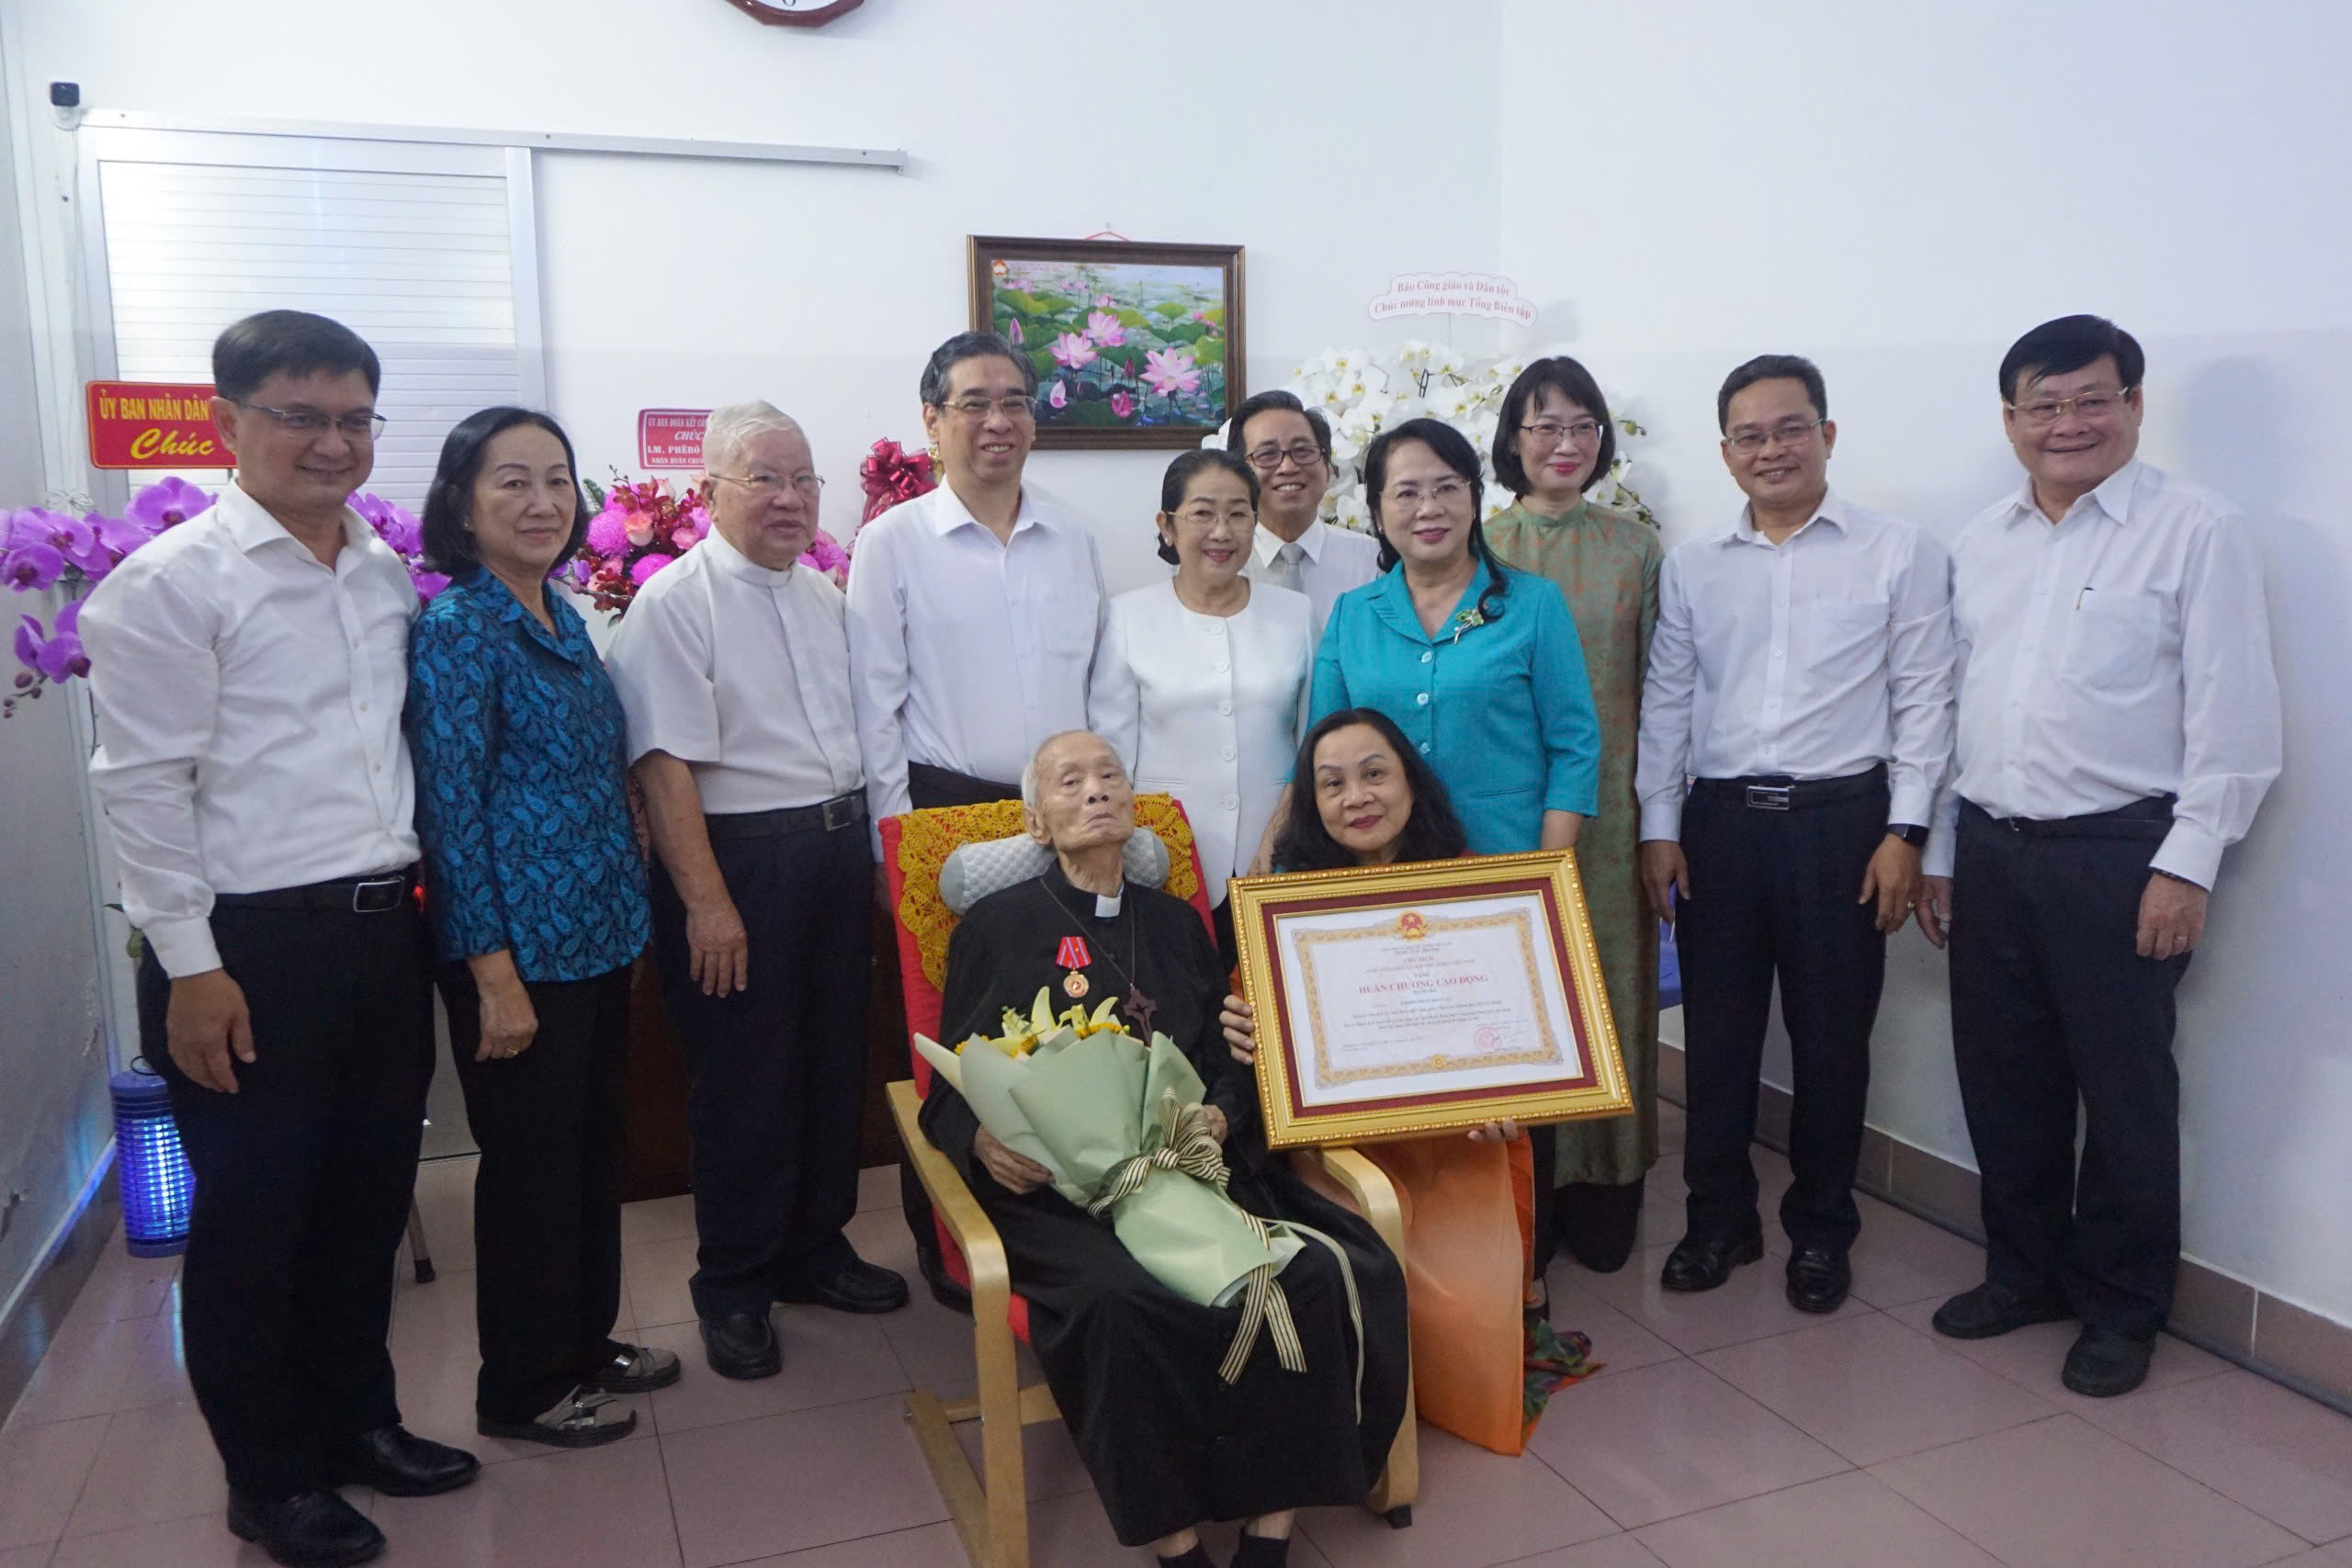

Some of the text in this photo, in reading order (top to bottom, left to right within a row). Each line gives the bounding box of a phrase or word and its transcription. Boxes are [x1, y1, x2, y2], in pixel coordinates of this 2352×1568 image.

[1417, 279, 1441, 292] Công
[1442, 280, 1462, 292] giáo
[1476, 281, 1495, 293] Dân
[1374, 301, 1398, 314] Chúc
[1428, 297, 1445, 307] linh
[99, 389, 210, 422] ỦY BAN NHÂN DÂN
[130, 427, 216, 459] Chúc
[647, 445, 666, 454] LM.
[1436, 975, 1457, 988] LAO
